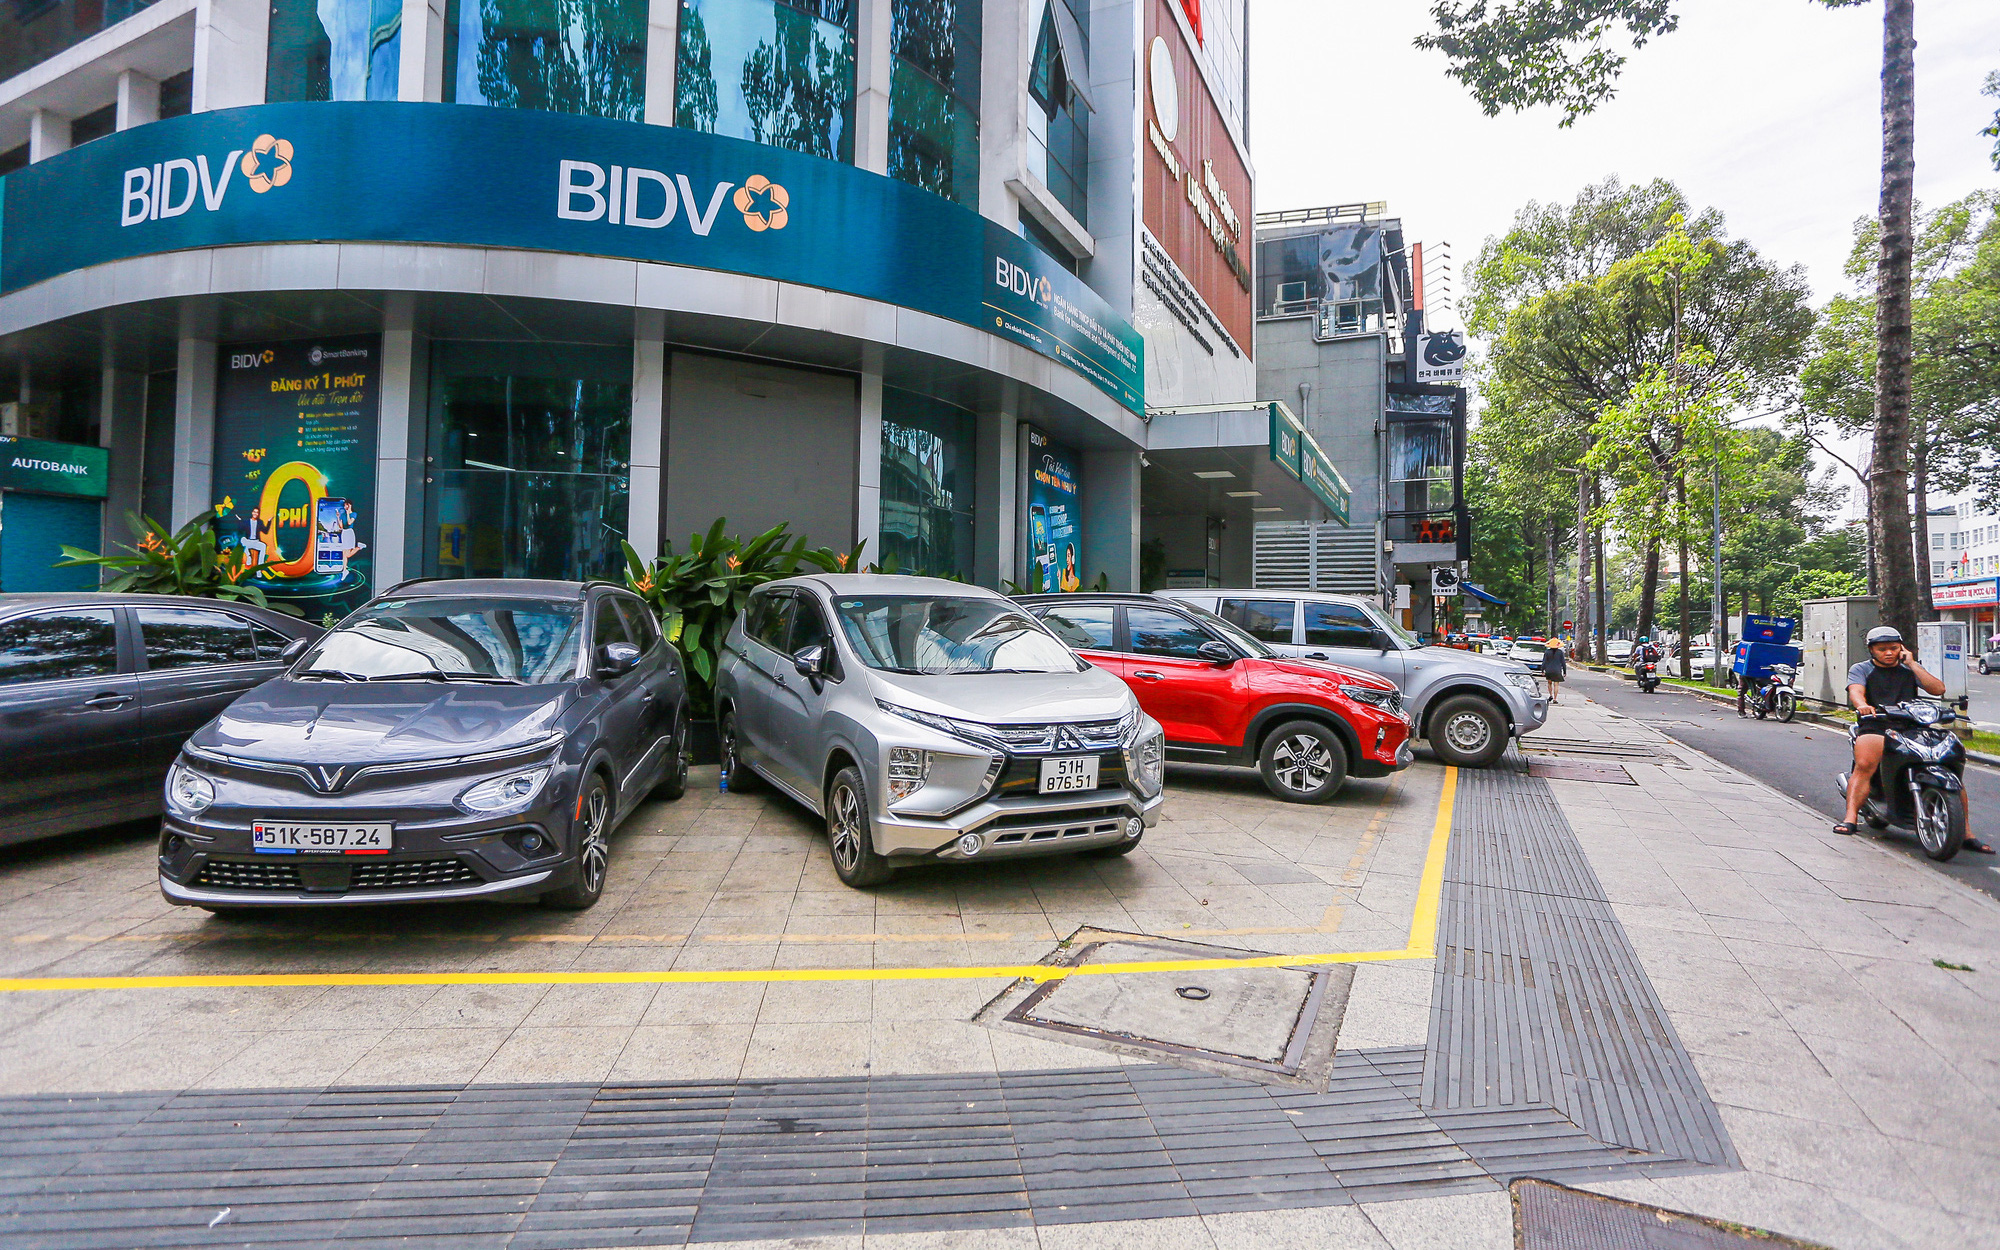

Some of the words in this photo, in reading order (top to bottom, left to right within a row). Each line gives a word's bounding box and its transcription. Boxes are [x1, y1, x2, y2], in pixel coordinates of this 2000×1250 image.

[121, 150, 243, 227] BIDV
[557, 159, 735, 237] BIDV
[996, 256, 1040, 302] BIDV
[231, 353, 262, 369] BIDV
[322, 349, 368, 359] SmartBanking
[271, 377, 302, 392] ĐĂNG
[304, 375, 320, 390] KÝ
[322, 372, 330, 389] 1
[334, 372, 366, 389] PHÚT
[12, 457, 88, 475] AUTOBANK
[278, 503, 309, 528] PHÍ
[1058, 760, 1083, 774] 51H
[1047, 775, 1091, 791] 876.51
[264, 827, 380, 845] 51K-587.24
